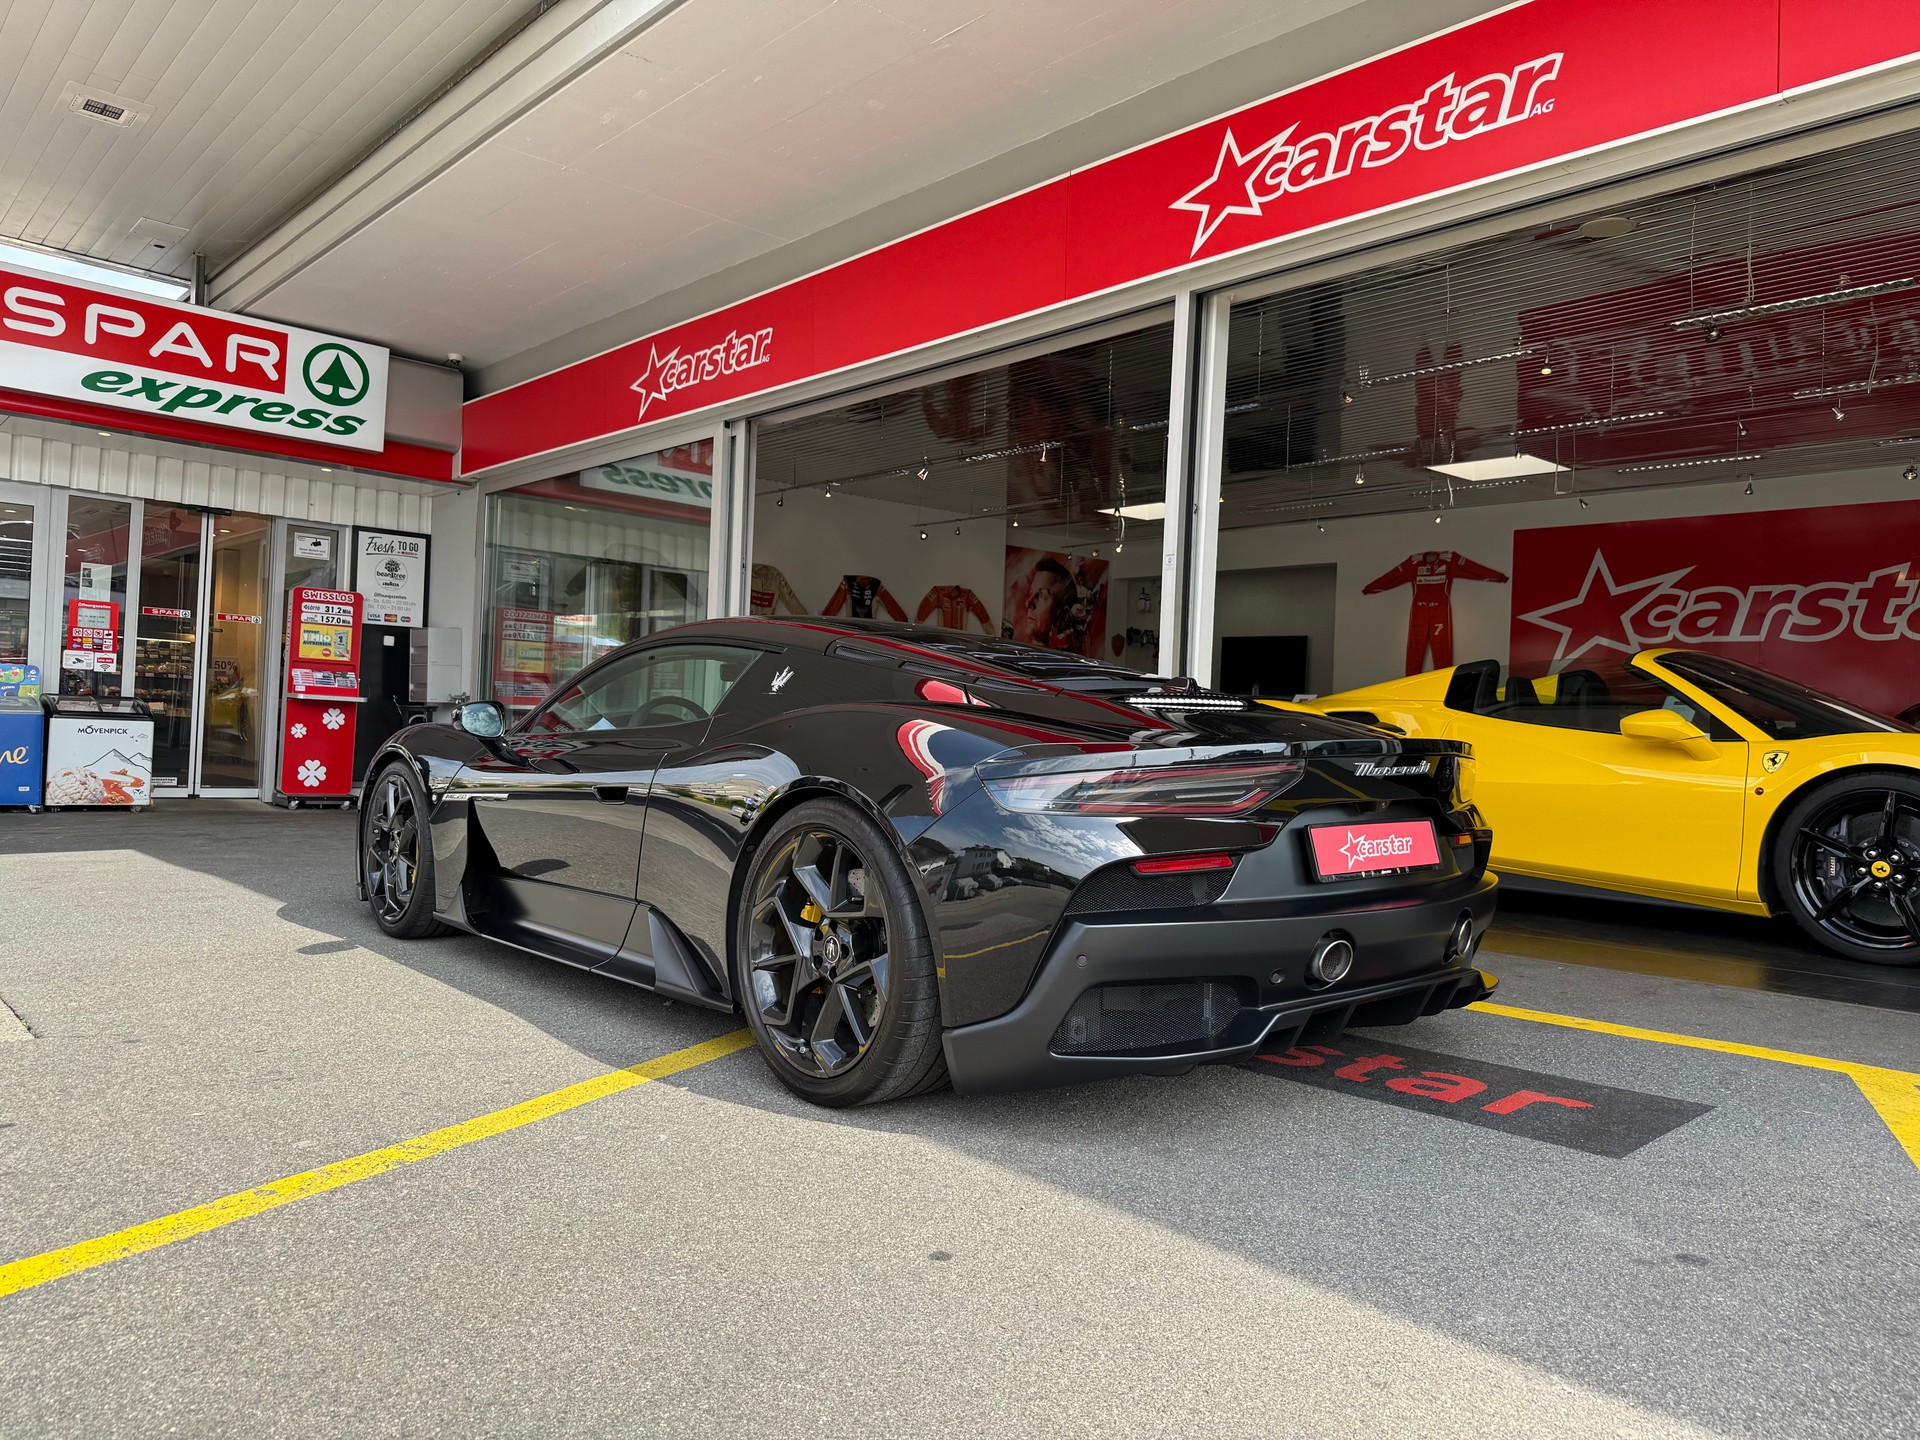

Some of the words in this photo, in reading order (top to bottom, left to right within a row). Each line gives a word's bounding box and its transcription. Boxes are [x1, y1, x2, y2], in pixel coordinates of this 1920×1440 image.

[1246, 52, 1564, 203] carstar
[1529, 98, 1555, 118] AG
[3, 286, 280, 381] SPAR
[661, 327, 773, 393] carstar
[762, 354, 770, 363] AG
[81, 370, 367, 436] express
[366, 536, 396, 553] Fresh
[398, 541, 407, 551] TO
[409, 543, 418, 552] GO
[302, 590, 354, 603] SWISSLOS
[152, 608, 180, 616] SPAR
[324, 606, 342, 614] 31.2
[225, 614, 252, 622] SPAR
[321, 616, 342, 624] 157.0
[1434, 624, 1444, 636] 7
[215, 660, 237, 671] 50%
[1357, 834, 1412, 858] carstar
